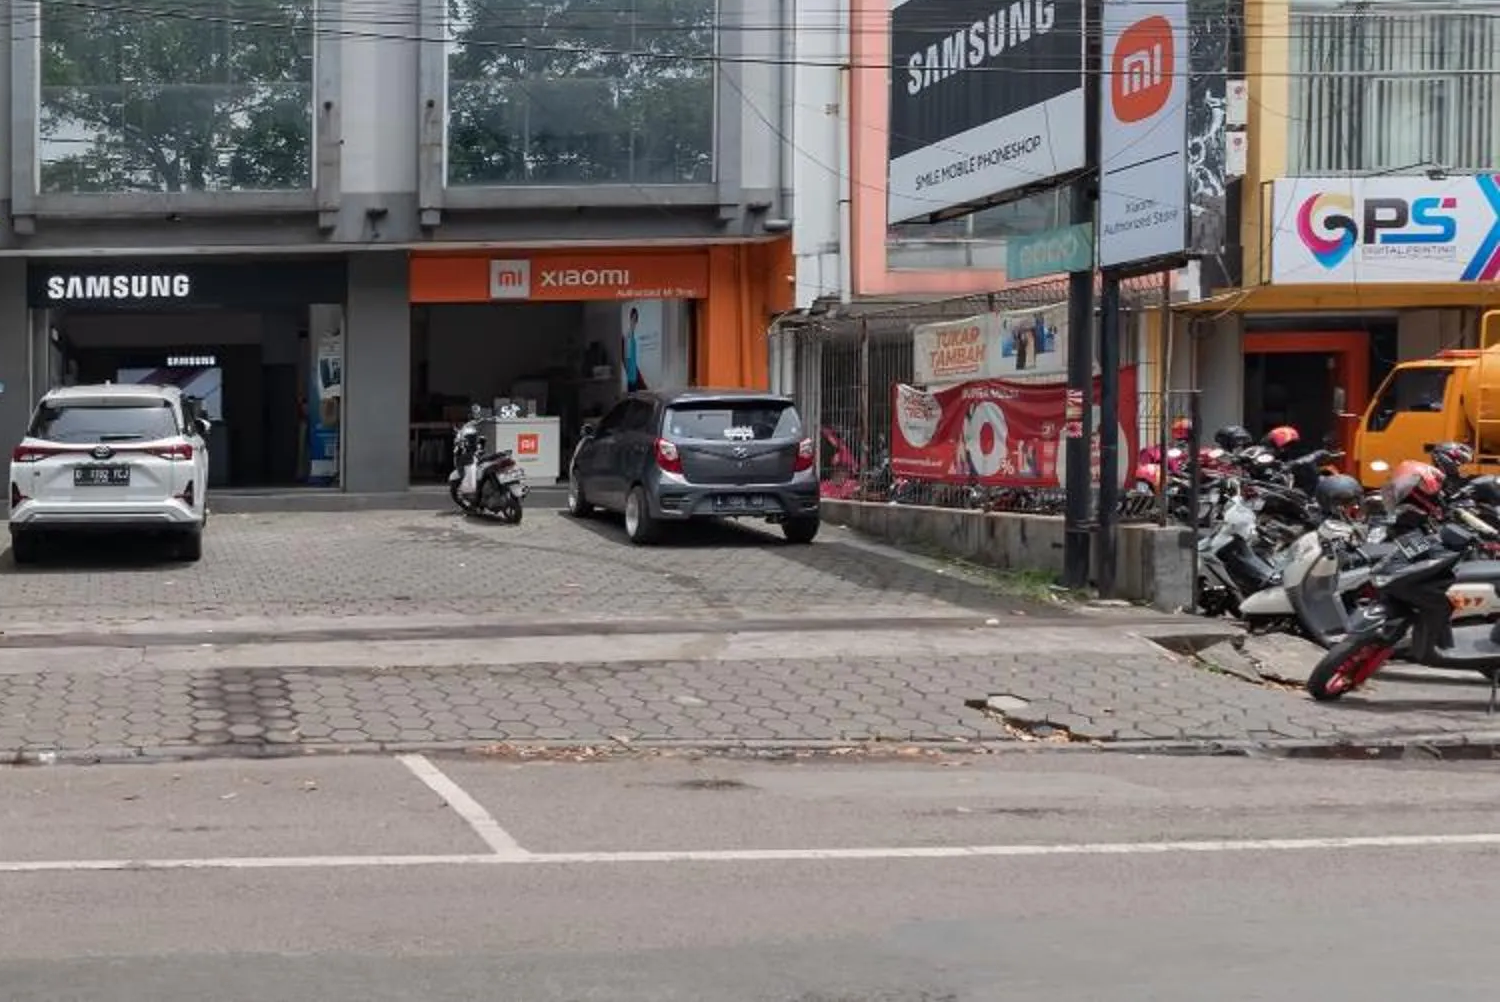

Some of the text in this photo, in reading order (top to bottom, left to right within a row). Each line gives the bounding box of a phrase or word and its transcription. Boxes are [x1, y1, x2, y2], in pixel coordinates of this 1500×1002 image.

[915, 134, 1041, 190] SMILE MOBILE PHONESHOP
[1296, 192, 1457, 270] GPS
[47, 274, 190, 299] SAMSUNG
[167, 356, 216, 367] SAMSUNG
